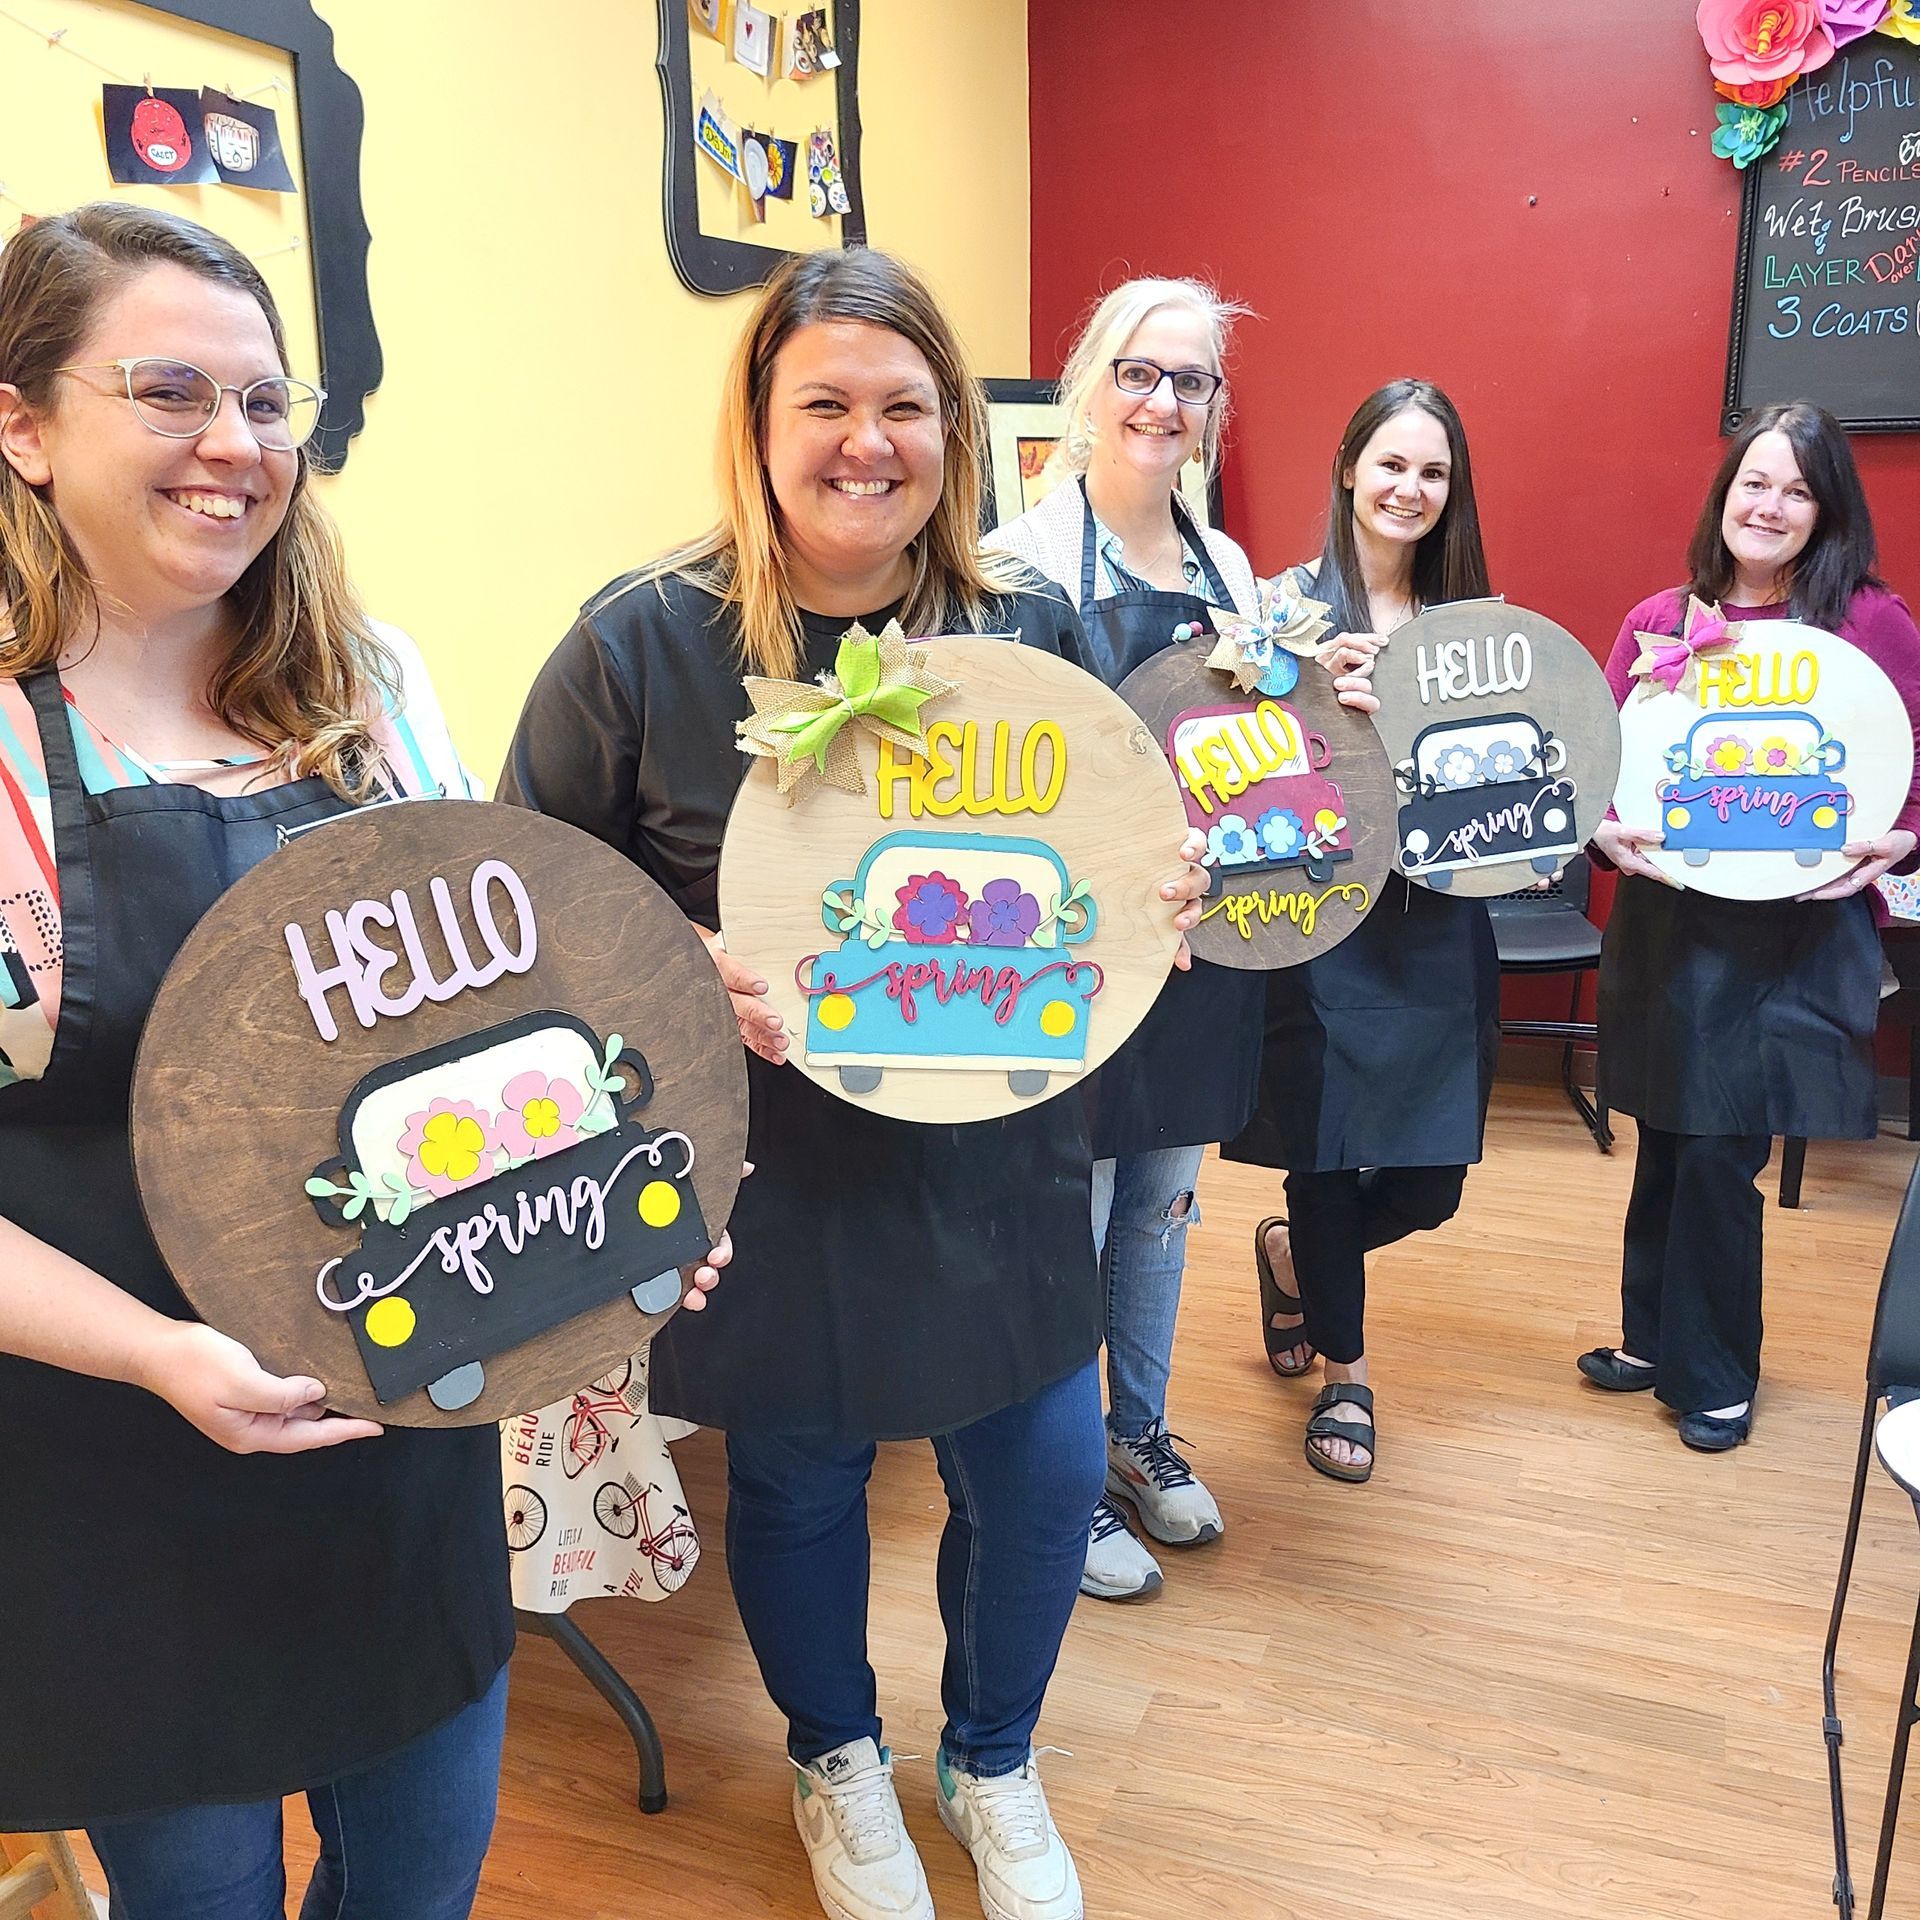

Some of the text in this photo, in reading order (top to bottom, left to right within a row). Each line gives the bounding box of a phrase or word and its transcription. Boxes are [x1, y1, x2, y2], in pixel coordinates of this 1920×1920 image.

[1783, 56, 1920, 142] Helpfu
[1778, 149, 1920, 186] #2 PENCILS
[1764, 198, 1823, 238] Wet
[1764, 228, 1920, 289] LAYER Dar over
[1768, 296, 1908, 338] 3 COATS
[1417, 632, 1532, 704] HELLO
[1699, 650, 1819, 707] HELLO
[876, 719, 1067, 818] HELLO
[1175, 700, 1297, 814] HELLO
[284, 860, 538, 1041] HELLO
[535, 1431, 556, 1467] RIDE
[552, 1549, 596, 1575] BEAFUL
[603, 1583, 617, 1593] A
